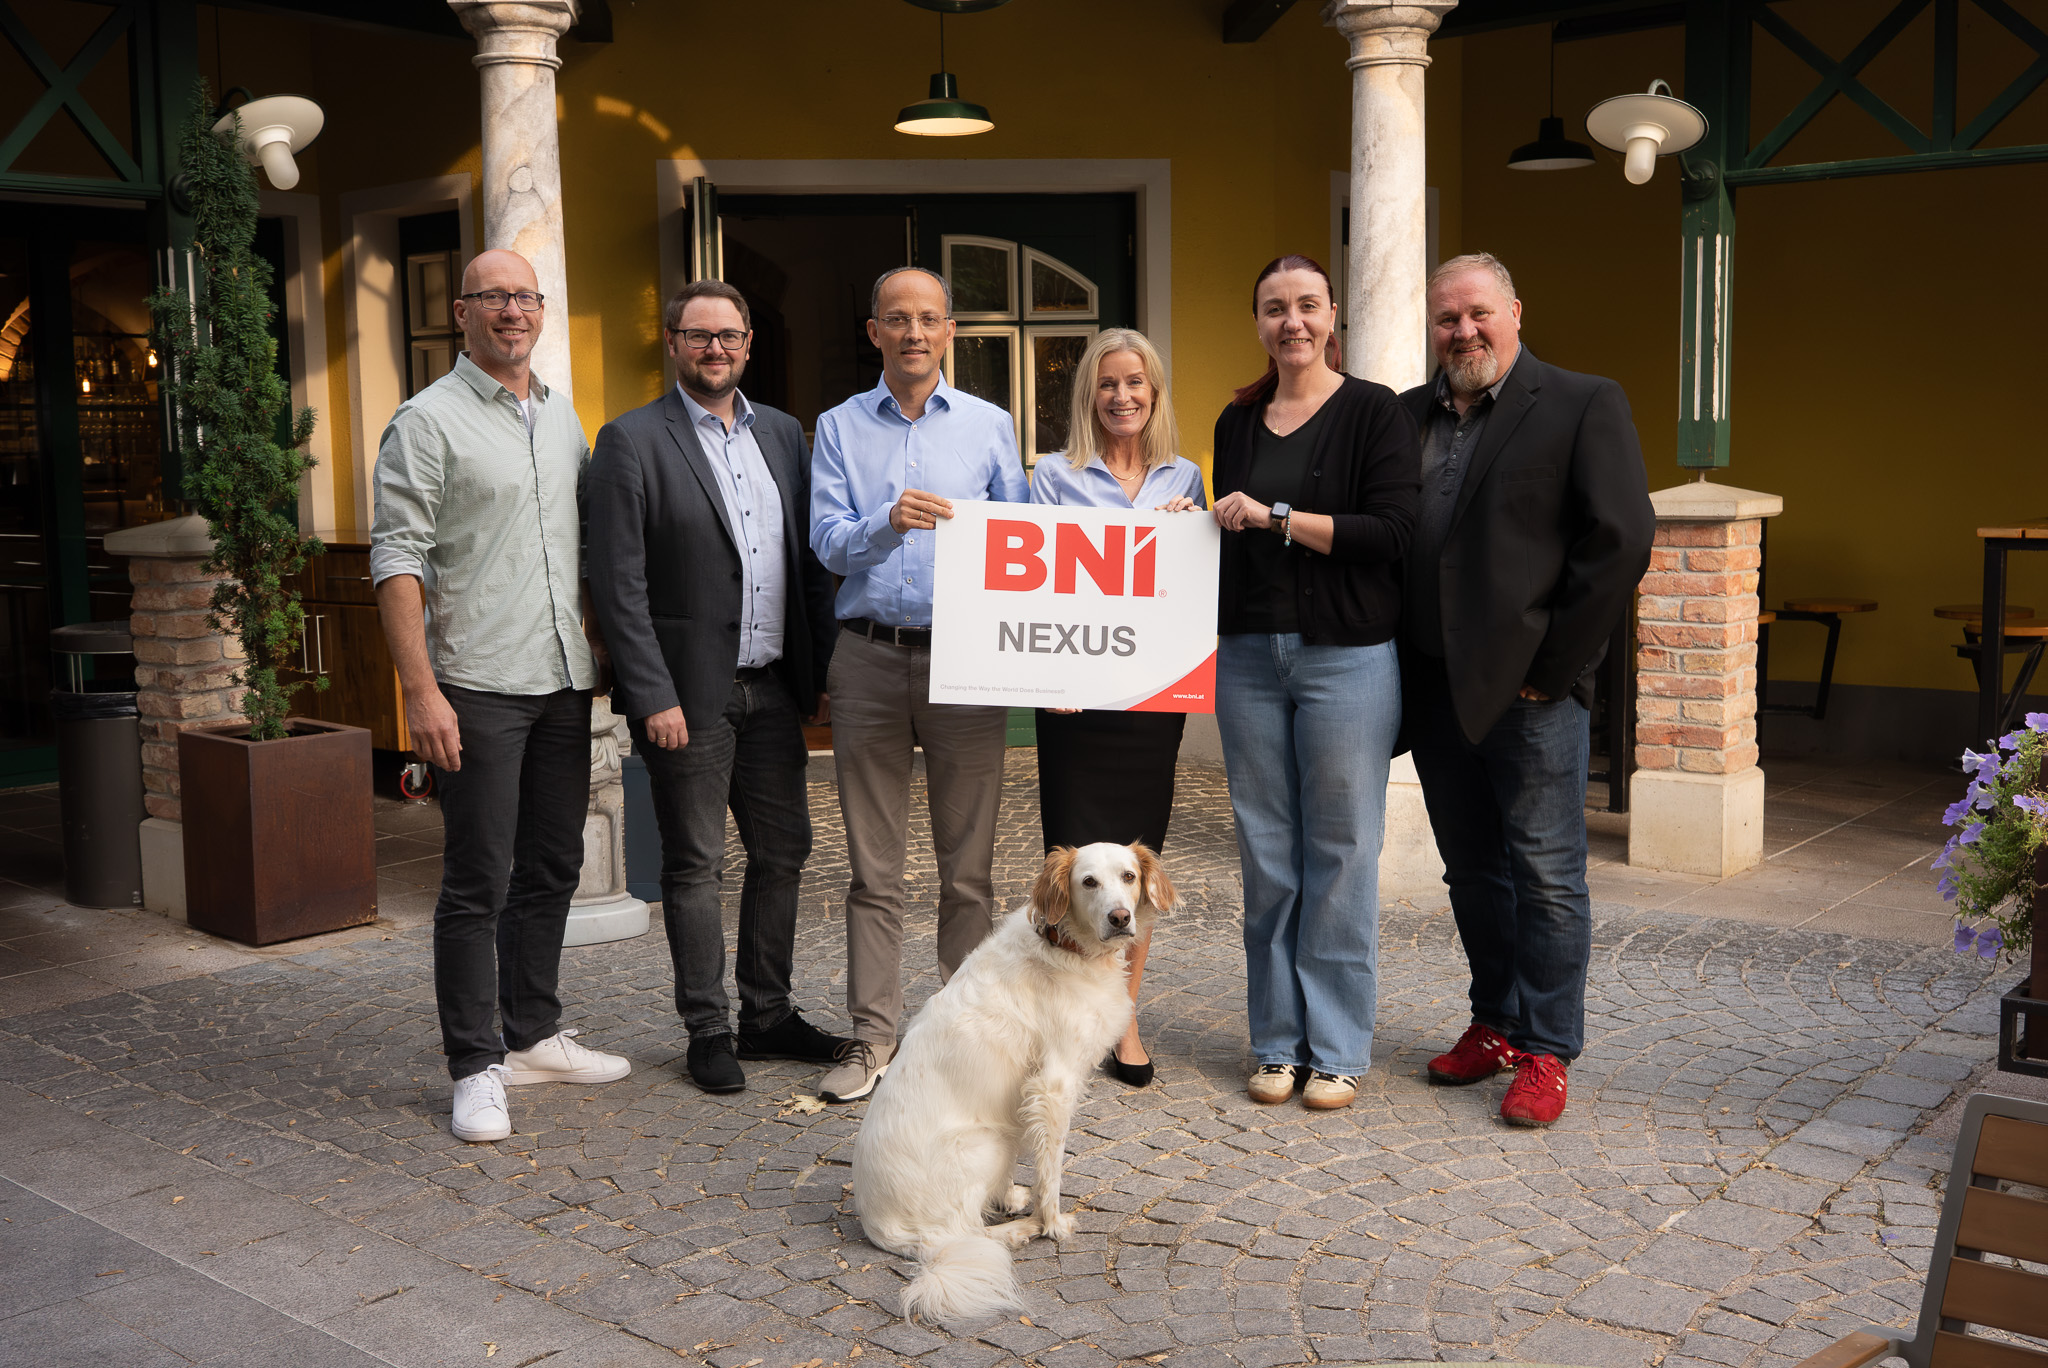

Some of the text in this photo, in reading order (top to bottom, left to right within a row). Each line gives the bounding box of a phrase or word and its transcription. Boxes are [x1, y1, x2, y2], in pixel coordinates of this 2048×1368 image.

[998, 621, 1137, 657] NEXUS
[940, 683, 967, 692] Changing
[978, 685, 991, 693] Way
